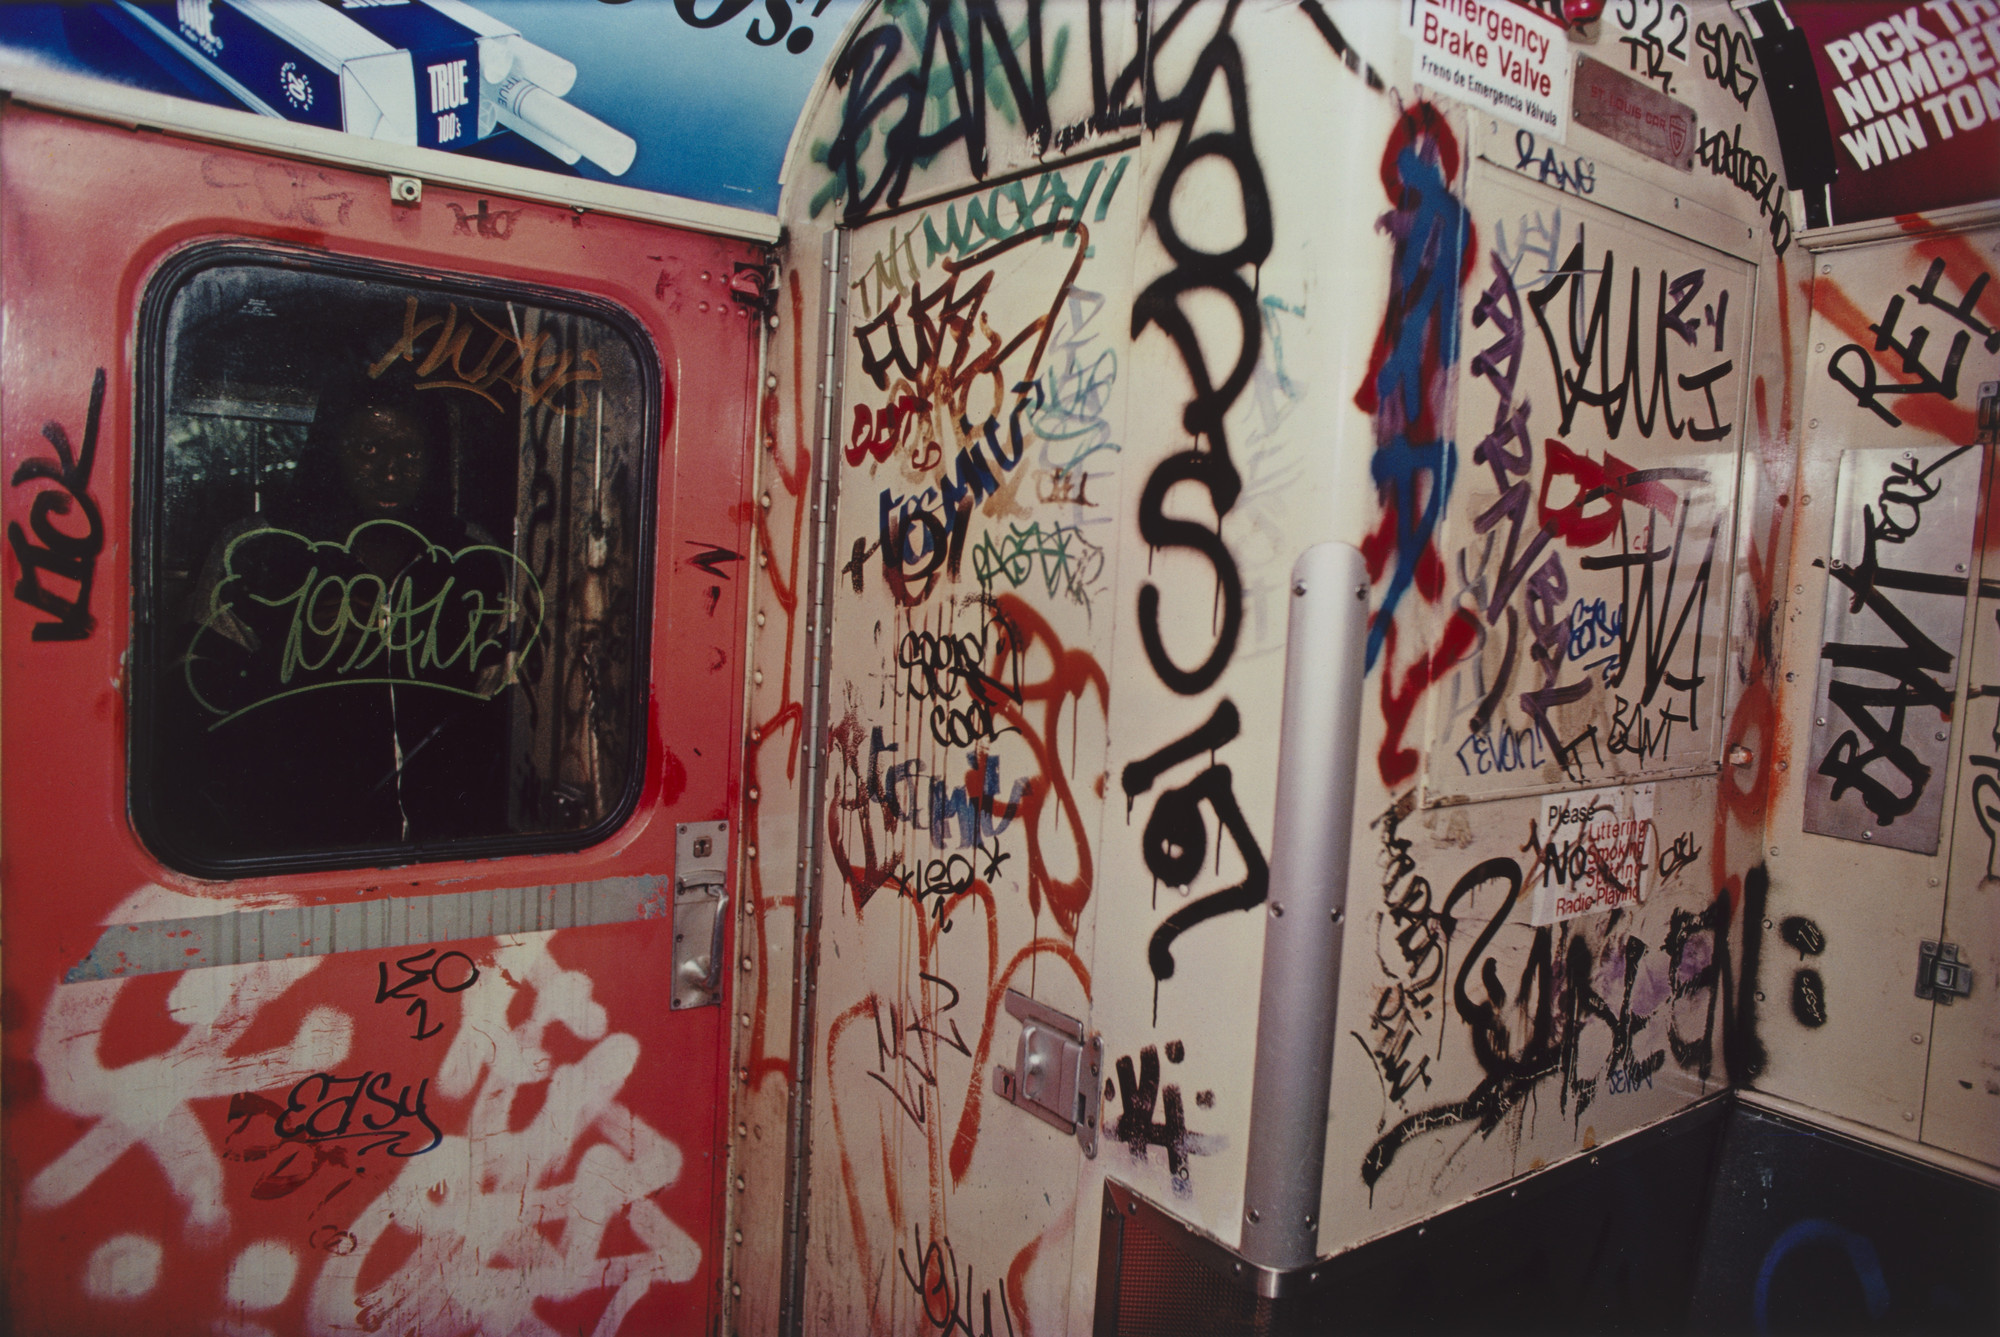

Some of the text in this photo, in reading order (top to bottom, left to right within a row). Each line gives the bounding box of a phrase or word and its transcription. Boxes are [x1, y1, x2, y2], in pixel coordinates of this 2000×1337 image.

[1423, 12, 1489, 69] Brake
[1499, 46, 1552, 98] Valve
[1434, 0, 1551, 65] mergency
[1824, 7, 1938, 82] PICK
[427, 59, 469, 114] TRUE
[1421, 54, 1453, 83] Freno
[1467, 74, 1524, 111] Emergencia
[1840, 107, 1928, 171] WIN
[1548, 804, 1596, 828] Please
[1586, 864, 1641, 890] Sptting
[1556, 894, 1594, 918] Radio
